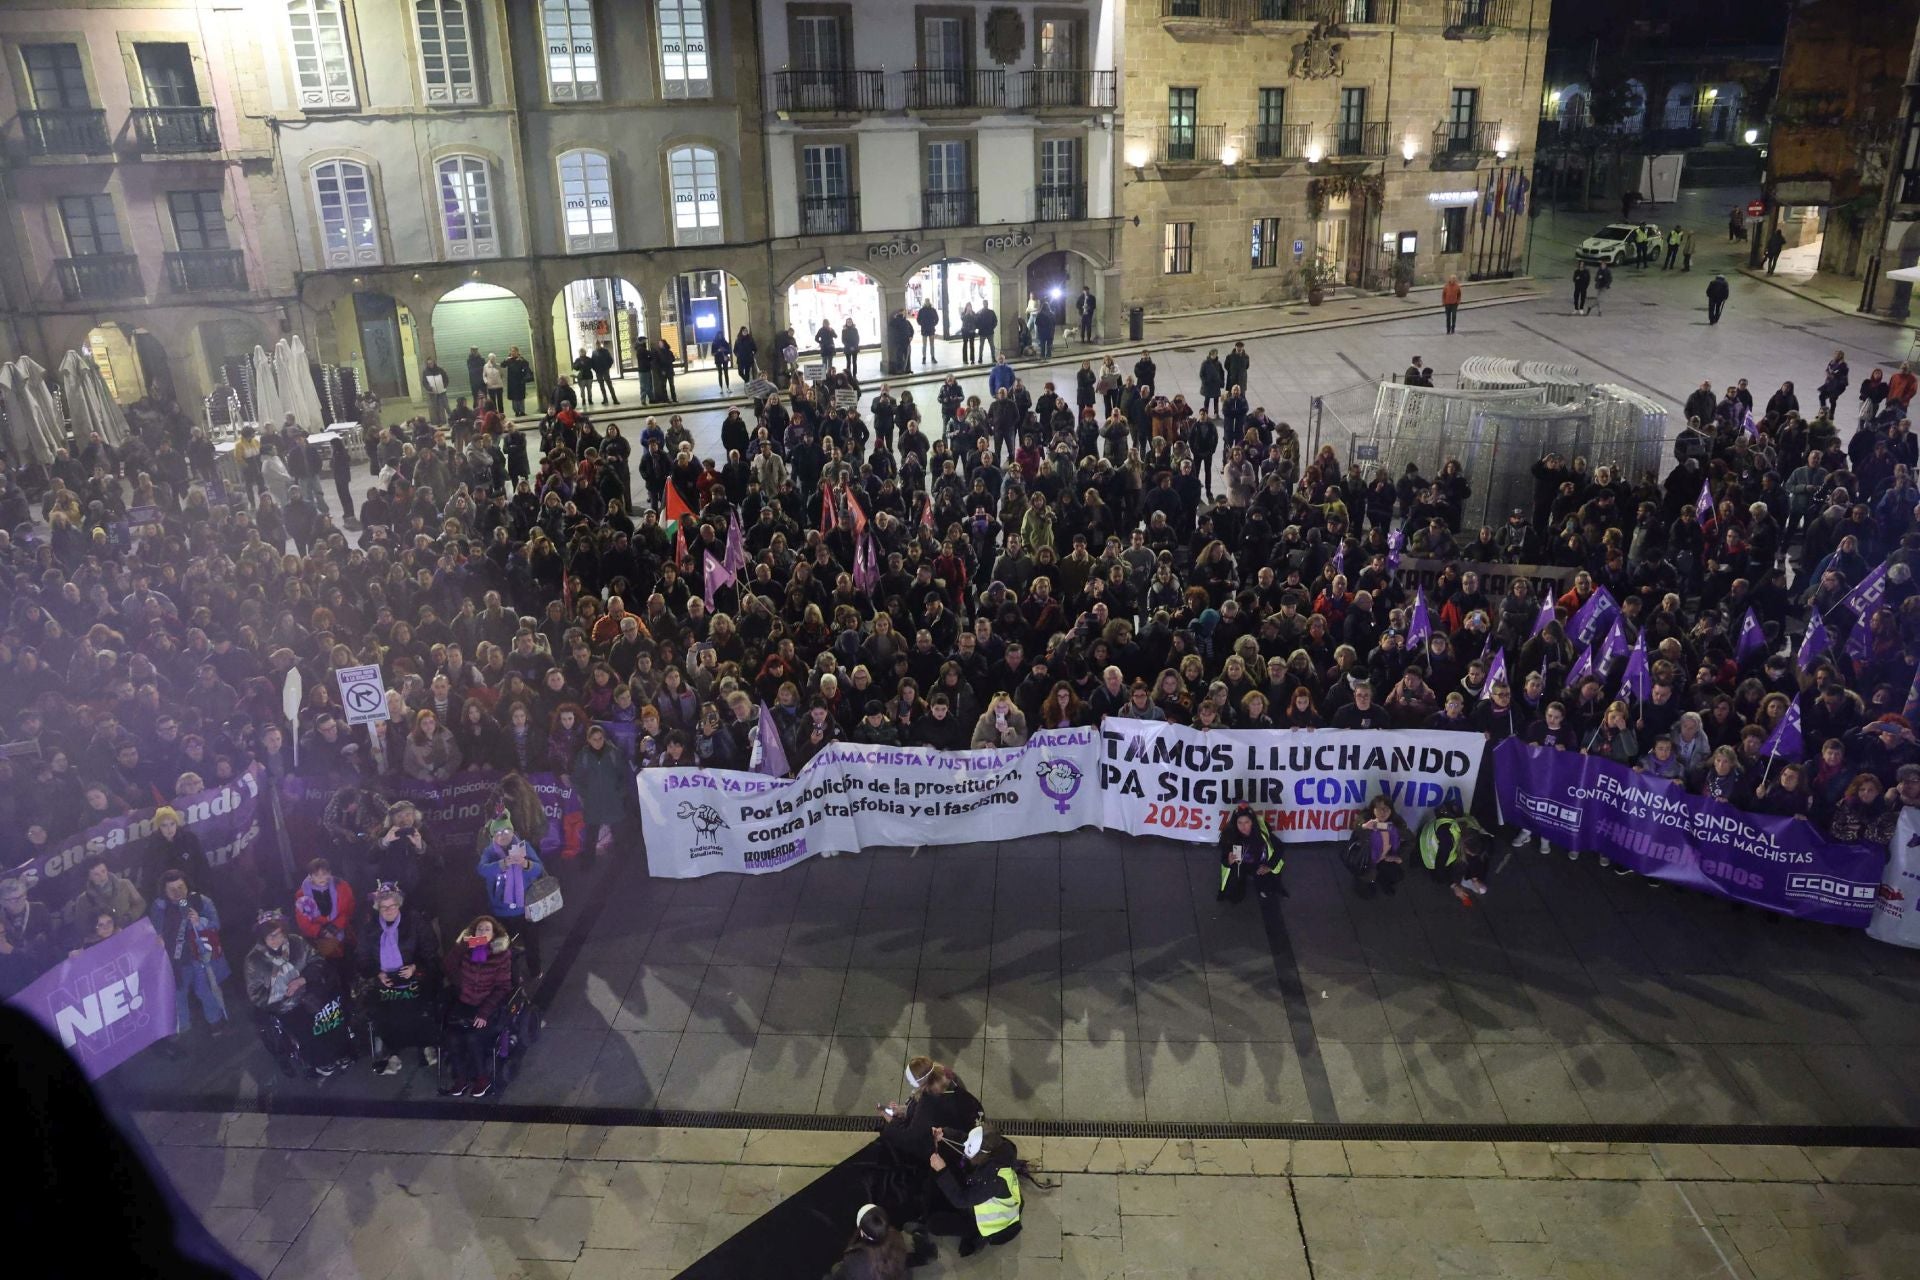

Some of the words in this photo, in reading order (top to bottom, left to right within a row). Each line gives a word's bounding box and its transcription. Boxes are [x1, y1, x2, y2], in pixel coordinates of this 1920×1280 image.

[868, 239, 920, 261] pepita
[985, 232, 1032, 254] pepita
[1103, 731, 1234, 772] TAMOS
[1247, 744, 1470, 777] LLUCHANDO
[664, 774, 718, 793] ¡BASTA
[722, 777, 741, 793] YA
[745, 781, 766, 793] DE
[841, 751, 922, 767] MACHISTA
[926, 754, 935, 767] Y
[938, 754, 1003, 771] JUSTICIA
[533, 782, 572, 799] mocional
[741, 805, 773, 822] Por
[776, 800, 793, 815] la
[868, 779, 890, 794] de
[894, 778, 910, 795] la
[1100, 763, 1146, 799] PA
[1157, 771, 1284, 805] SIGUIR
[1294, 777, 1367, 806] CON
[1379, 779, 1465, 818] VIDA
[1519, 793, 1559, 817] CCOO
[459, 802, 480, 818] no
[747, 817, 805, 843] contra
[807, 809, 822, 826] la
[909, 805, 922, 817] y
[924, 802, 940, 816] el
[944, 791, 1019, 816] fascismo
[1144, 803, 1212, 830] 2025:
[1567, 786, 1618, 809] CONTRA
[1622, 803, 1646, 818] LAS
[1651, 812, 1729, 844] VIOLENCIAS
[1733, 837, 1813, 864] MACHISTAS
[1693, 812, 1780, 849] SINDICAL
[744, 842, 796, 863] IZQUIERDA
[1792, 877, 1850, 897] CCOO
[55, 970, 144, 1049] NE!
